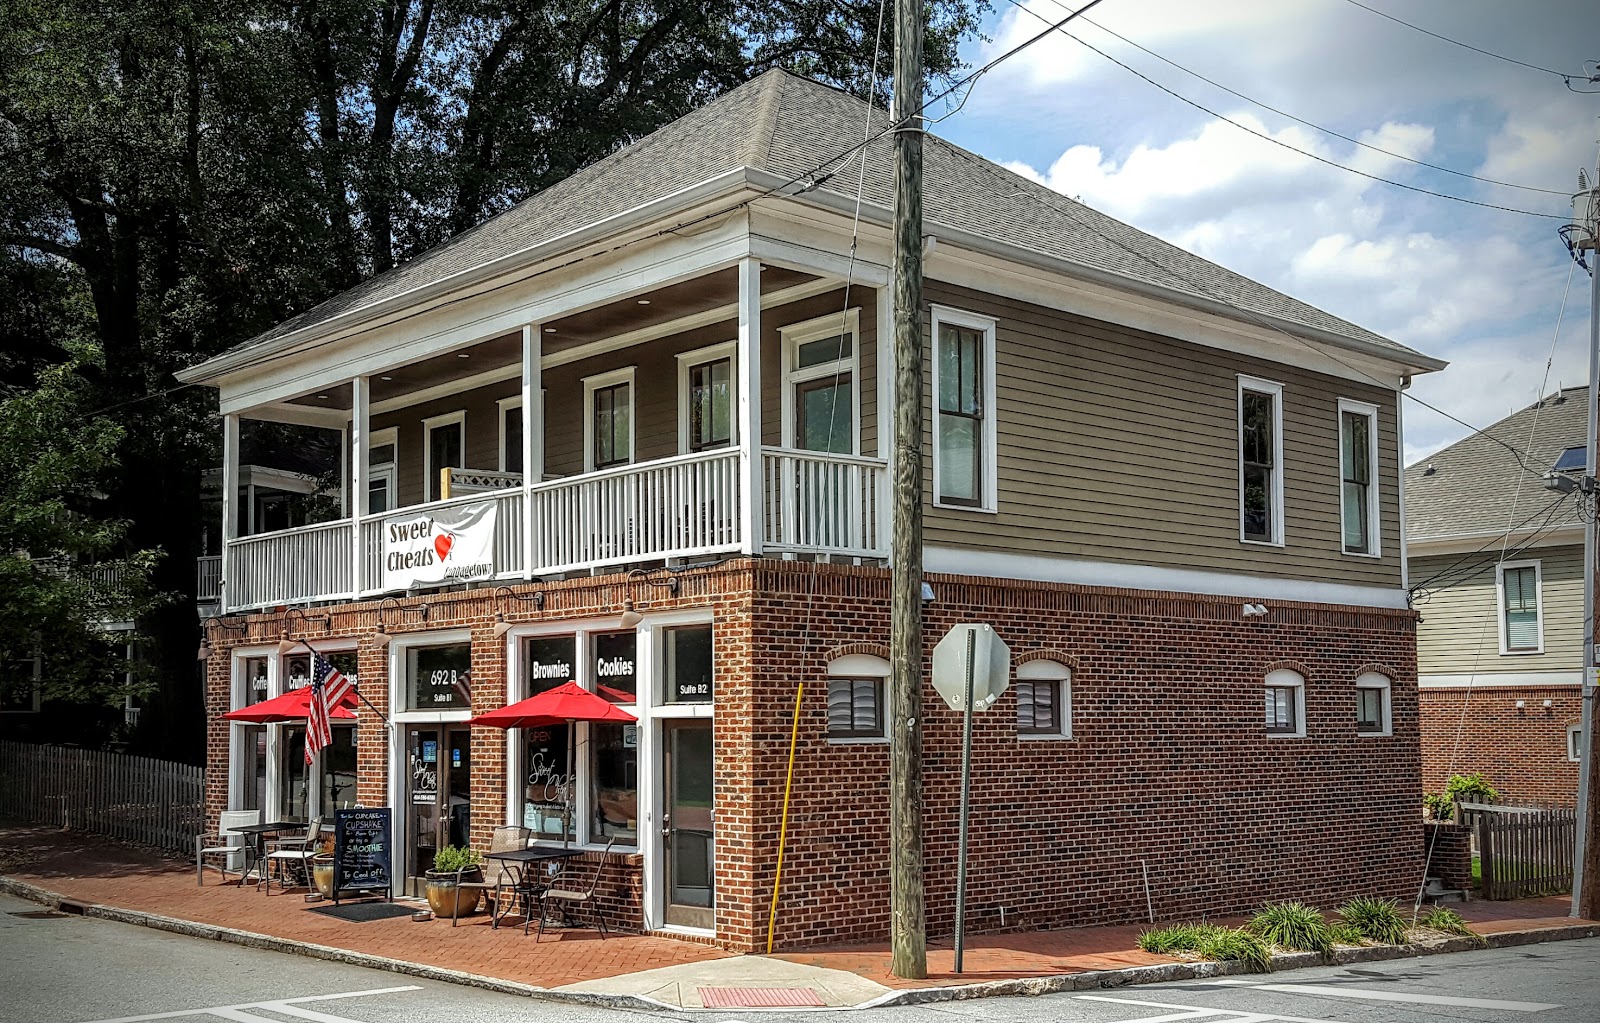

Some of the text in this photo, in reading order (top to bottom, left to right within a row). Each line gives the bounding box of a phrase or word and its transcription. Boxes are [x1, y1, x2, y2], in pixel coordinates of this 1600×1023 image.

[390, 517, 434, 543] Sweet
[387, 546, 434, 572] Cheats
[533, 659, 570, 680] Brownies
[597, 656, 633, 677] Cookies
[252, 675, 268, 691] Coffe
[430, 669, 457, 685] 692 B
[433, 693, 446, 702] Suite
[680, 684, 708, 695] Suite B2
[345, 820, 383, 829] CUPSHAKE
[346, 843, 384, 853] SMOOTHIE
[343, 870, 352, 879] To
[353, 870, 369, 879] Cool
